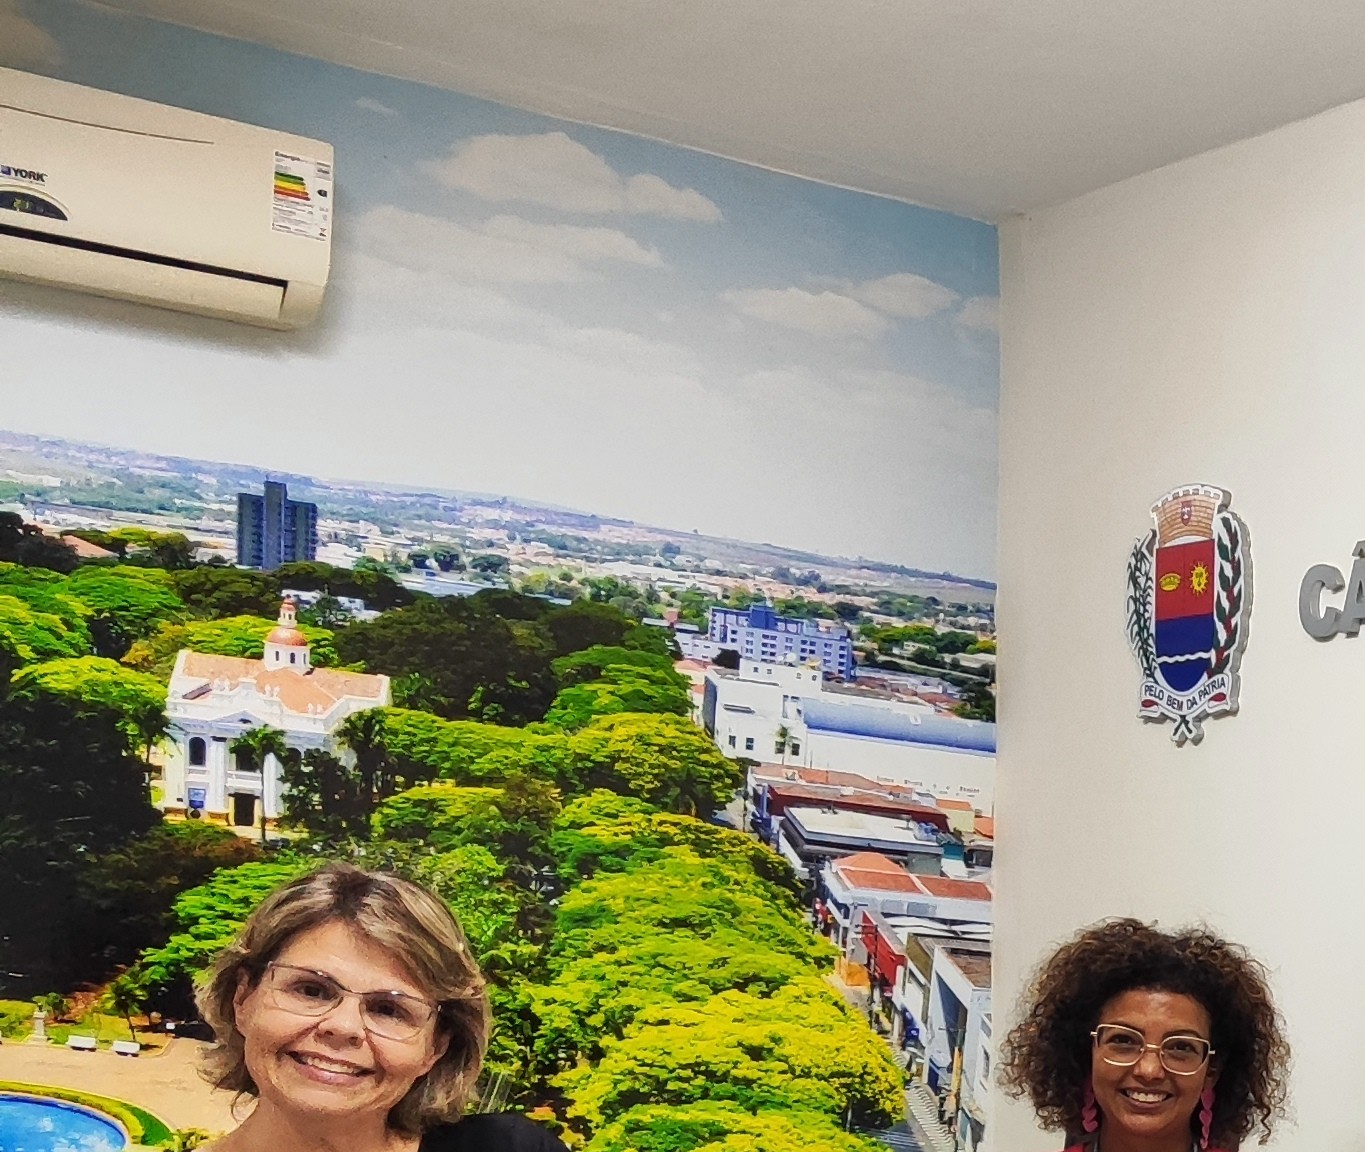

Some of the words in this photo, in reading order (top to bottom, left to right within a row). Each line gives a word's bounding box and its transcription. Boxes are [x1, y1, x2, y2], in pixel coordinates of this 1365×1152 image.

[12, 167, 46, 182] YORK
[1144, 684, 1165, 701] PELO
[1166, 694, 1183, 712] BEM
[1186, 696, 1198, 711] DA
